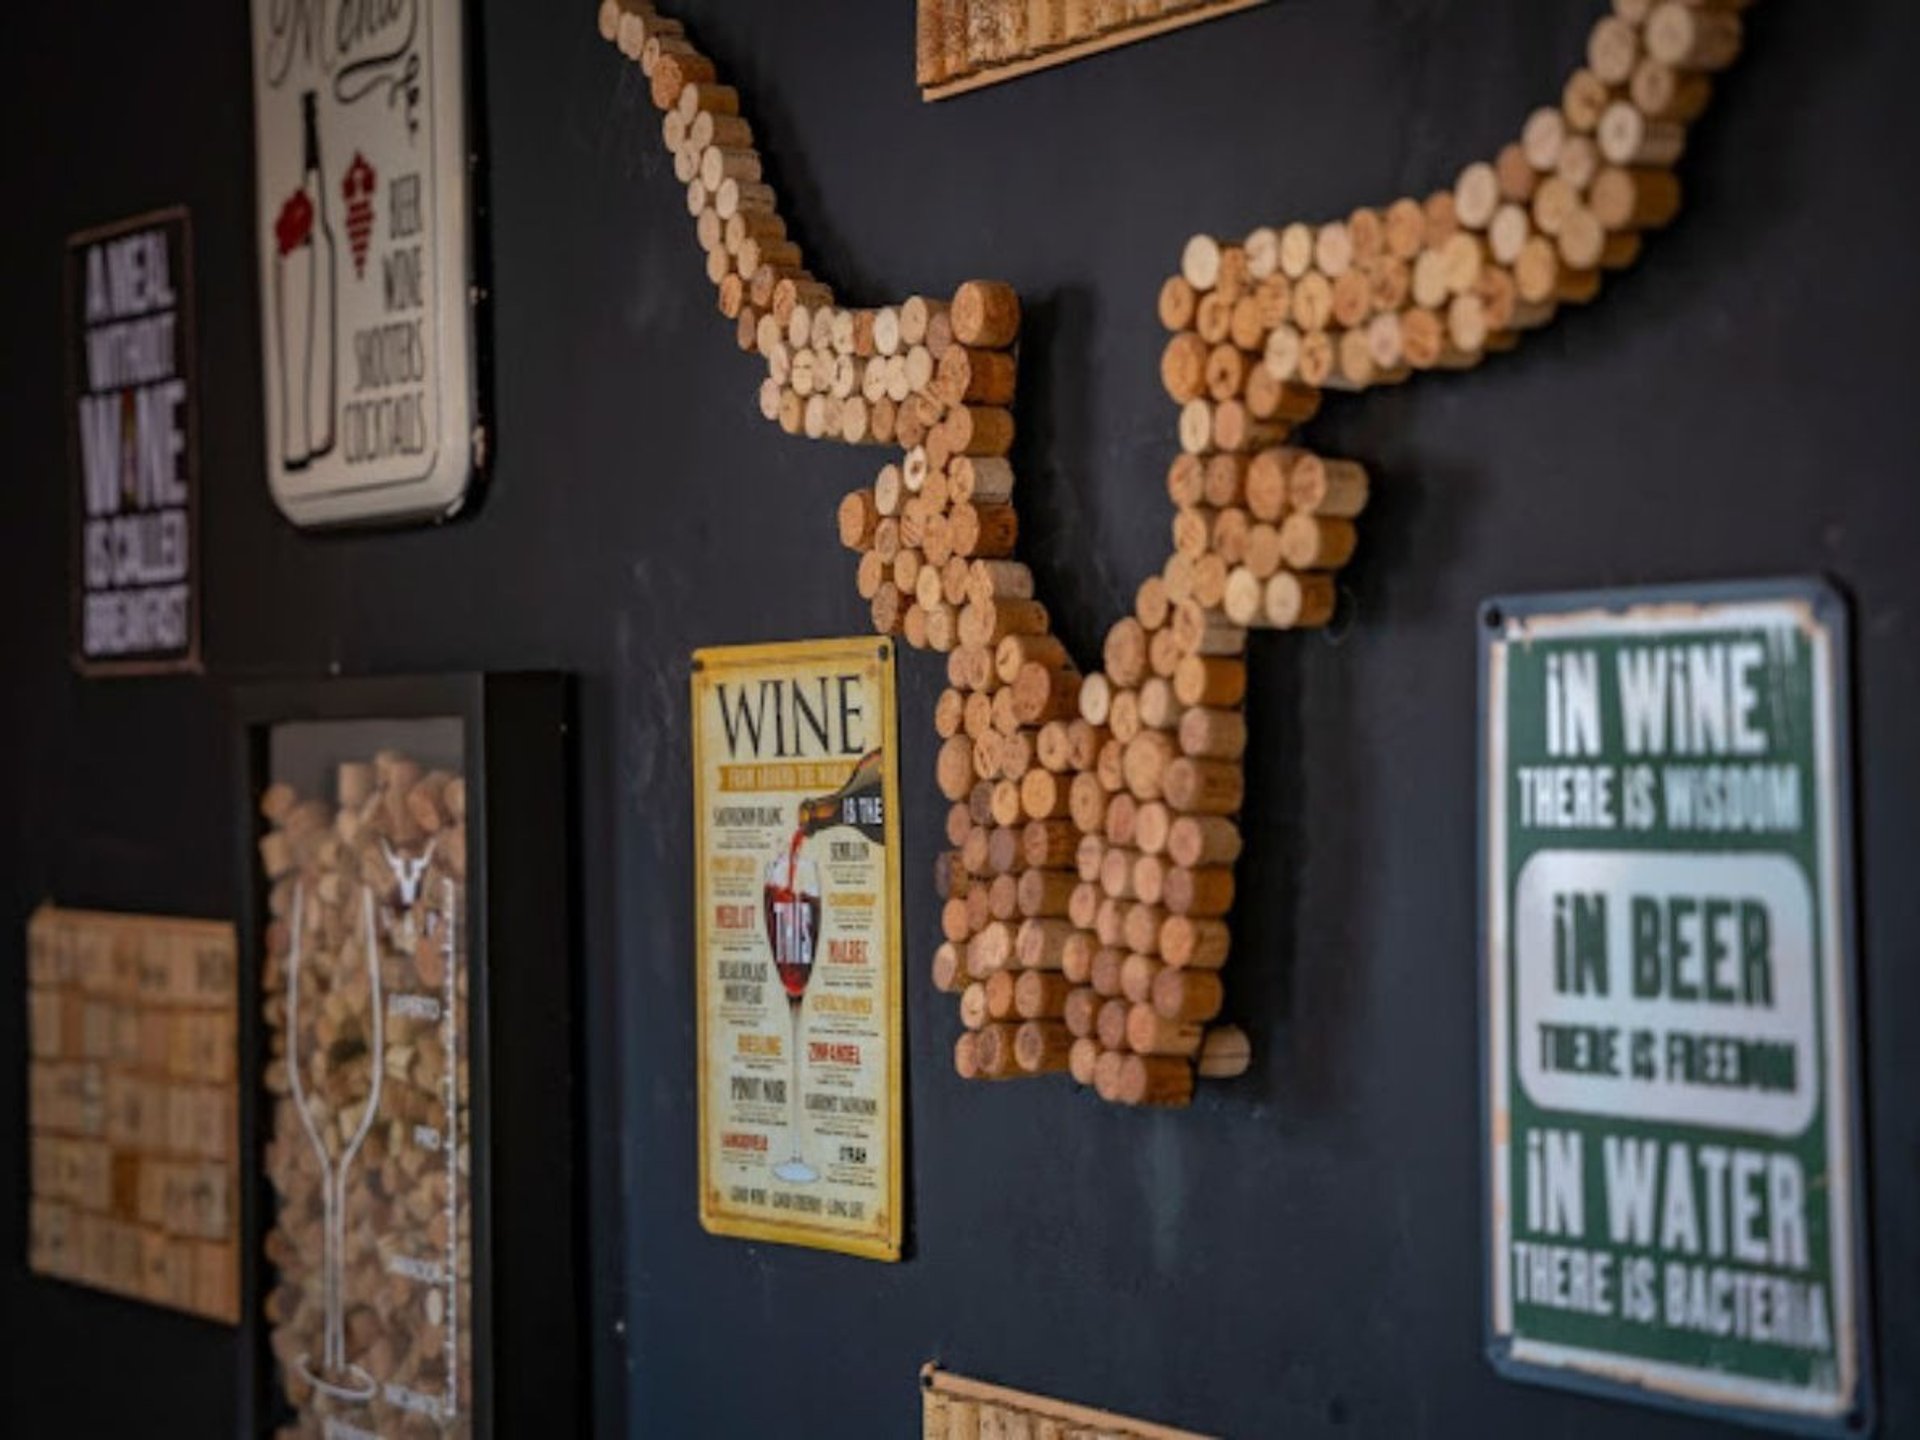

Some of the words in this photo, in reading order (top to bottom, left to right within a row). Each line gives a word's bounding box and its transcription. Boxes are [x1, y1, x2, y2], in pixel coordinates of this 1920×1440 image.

[715, 674, 865, 760] WINE
[842, 796, 857, 824] IS
[1518, 766, 1616, 830] THERE
[1622, 765, 1655, 830] IS
[1662, 765, 1801, 831] WISDOM
[1631, 895, 1774, 1008] BEER
[1538, 1021, 1622, 1077] THERE
[1630, 1028, 1657, 1082] IS
[1665, 1032, 1798, 1093] FREEDOM
[1603, 1136, 1809, 1268] WATER
[1513, 1240, 1614, 1316] THERE
[1620, 1256, 1656, 1324] IS
[1664, 1260, 1832, 1352] BACTERIA
